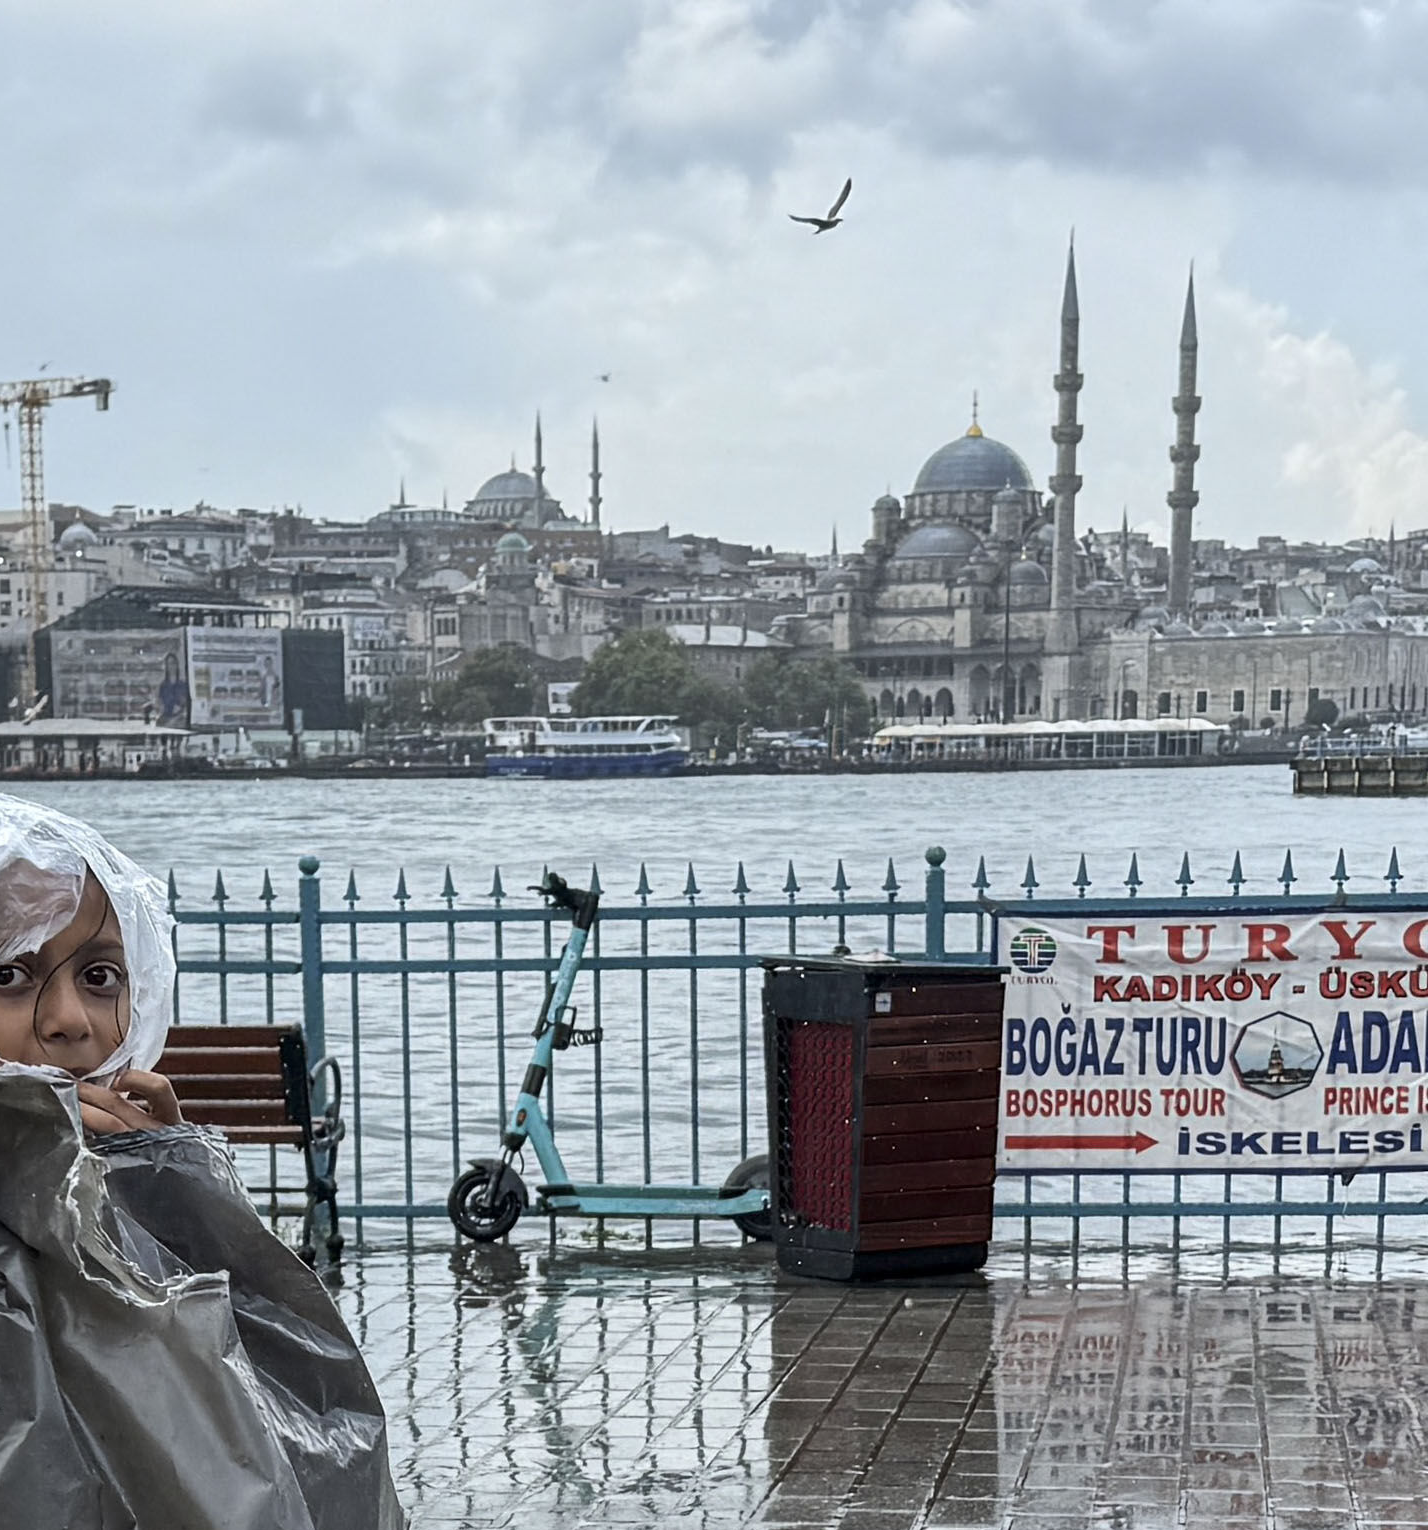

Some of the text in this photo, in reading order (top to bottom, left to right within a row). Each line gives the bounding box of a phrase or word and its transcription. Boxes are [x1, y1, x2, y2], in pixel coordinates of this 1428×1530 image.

[1093, 967, 1281, 1002] KADIKÖY
[1006, 1002, 1227, 1076] BOĞAZ TURU
[1006, 1088, 1225, 1117] BOSPHORUS TOUR
[1323, 1086, 1409, 1115] PRINCE
[1178, 1123, 1423, 1156] İSKELESİ
